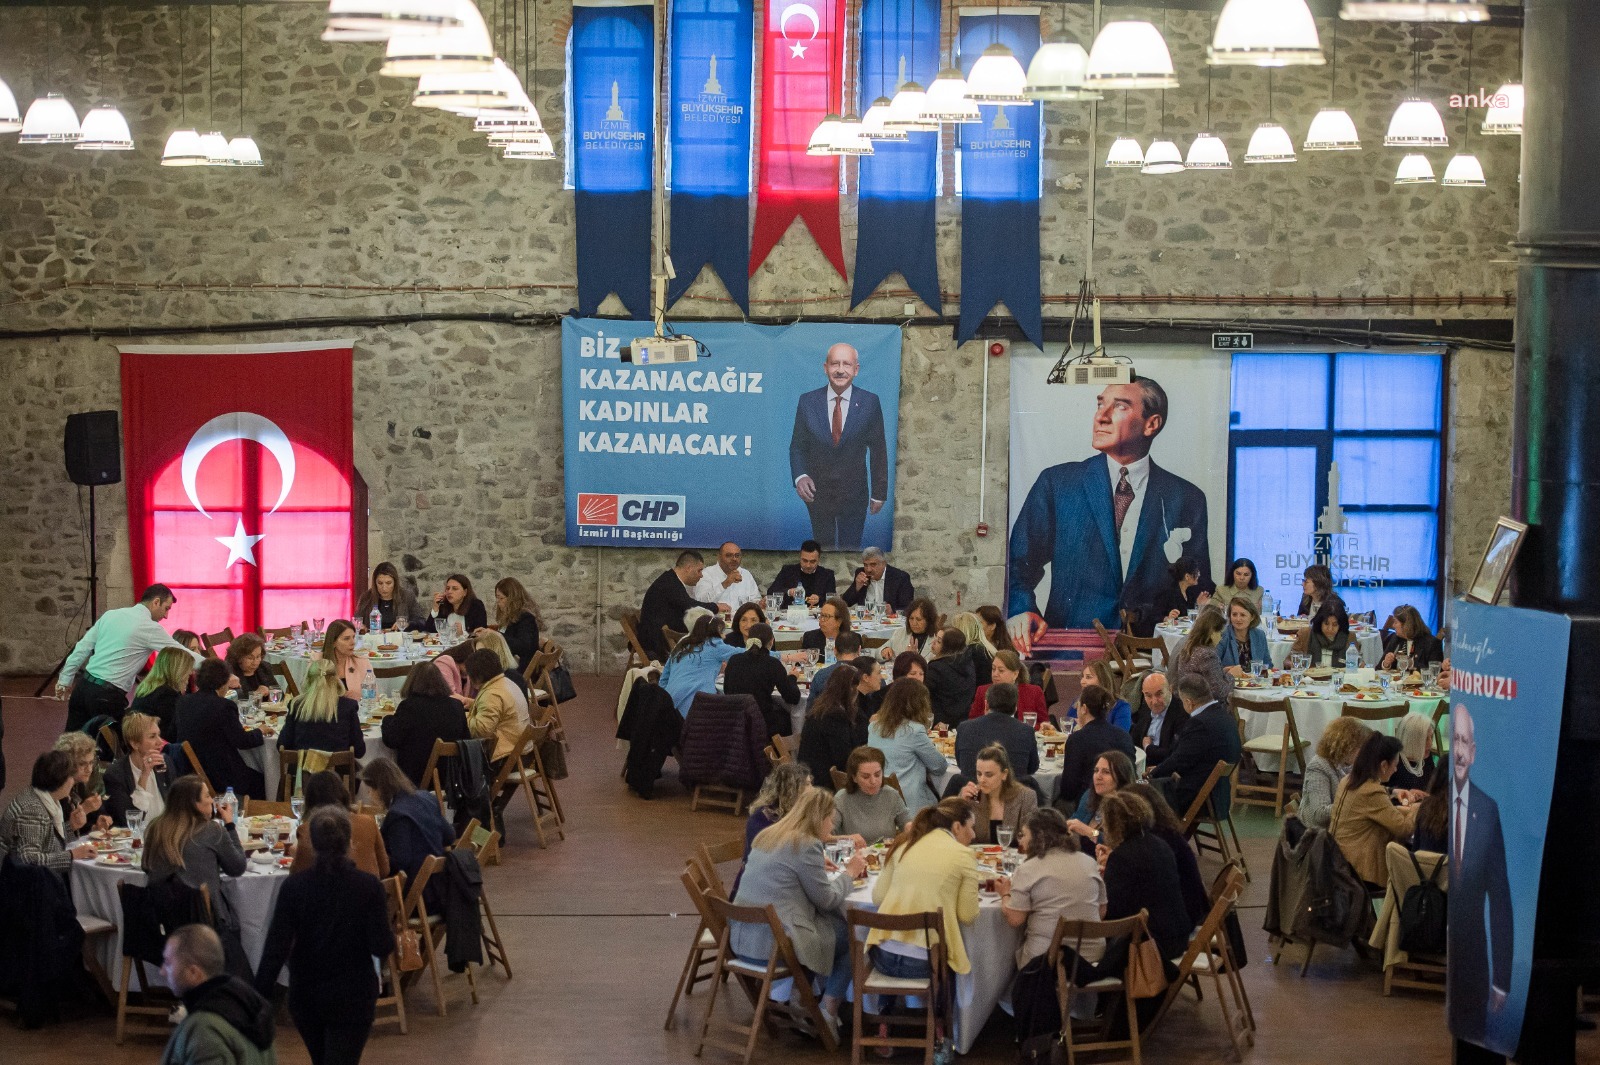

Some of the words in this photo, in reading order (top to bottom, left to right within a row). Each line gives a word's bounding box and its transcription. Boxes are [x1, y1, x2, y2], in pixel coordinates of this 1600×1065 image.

[580, 331, 620, 359] BİZ
[580, 366, 763, 393] KAZANACAĞIZ
[579, 400, 709, 424] KADINLAR
[578, 432, 738, 456] KAZANACAK
[622, 500, 680, 522] CHP
[579, 526, 609, 538] İzmir
[622, 529, 683, 542] Başkanlığı
